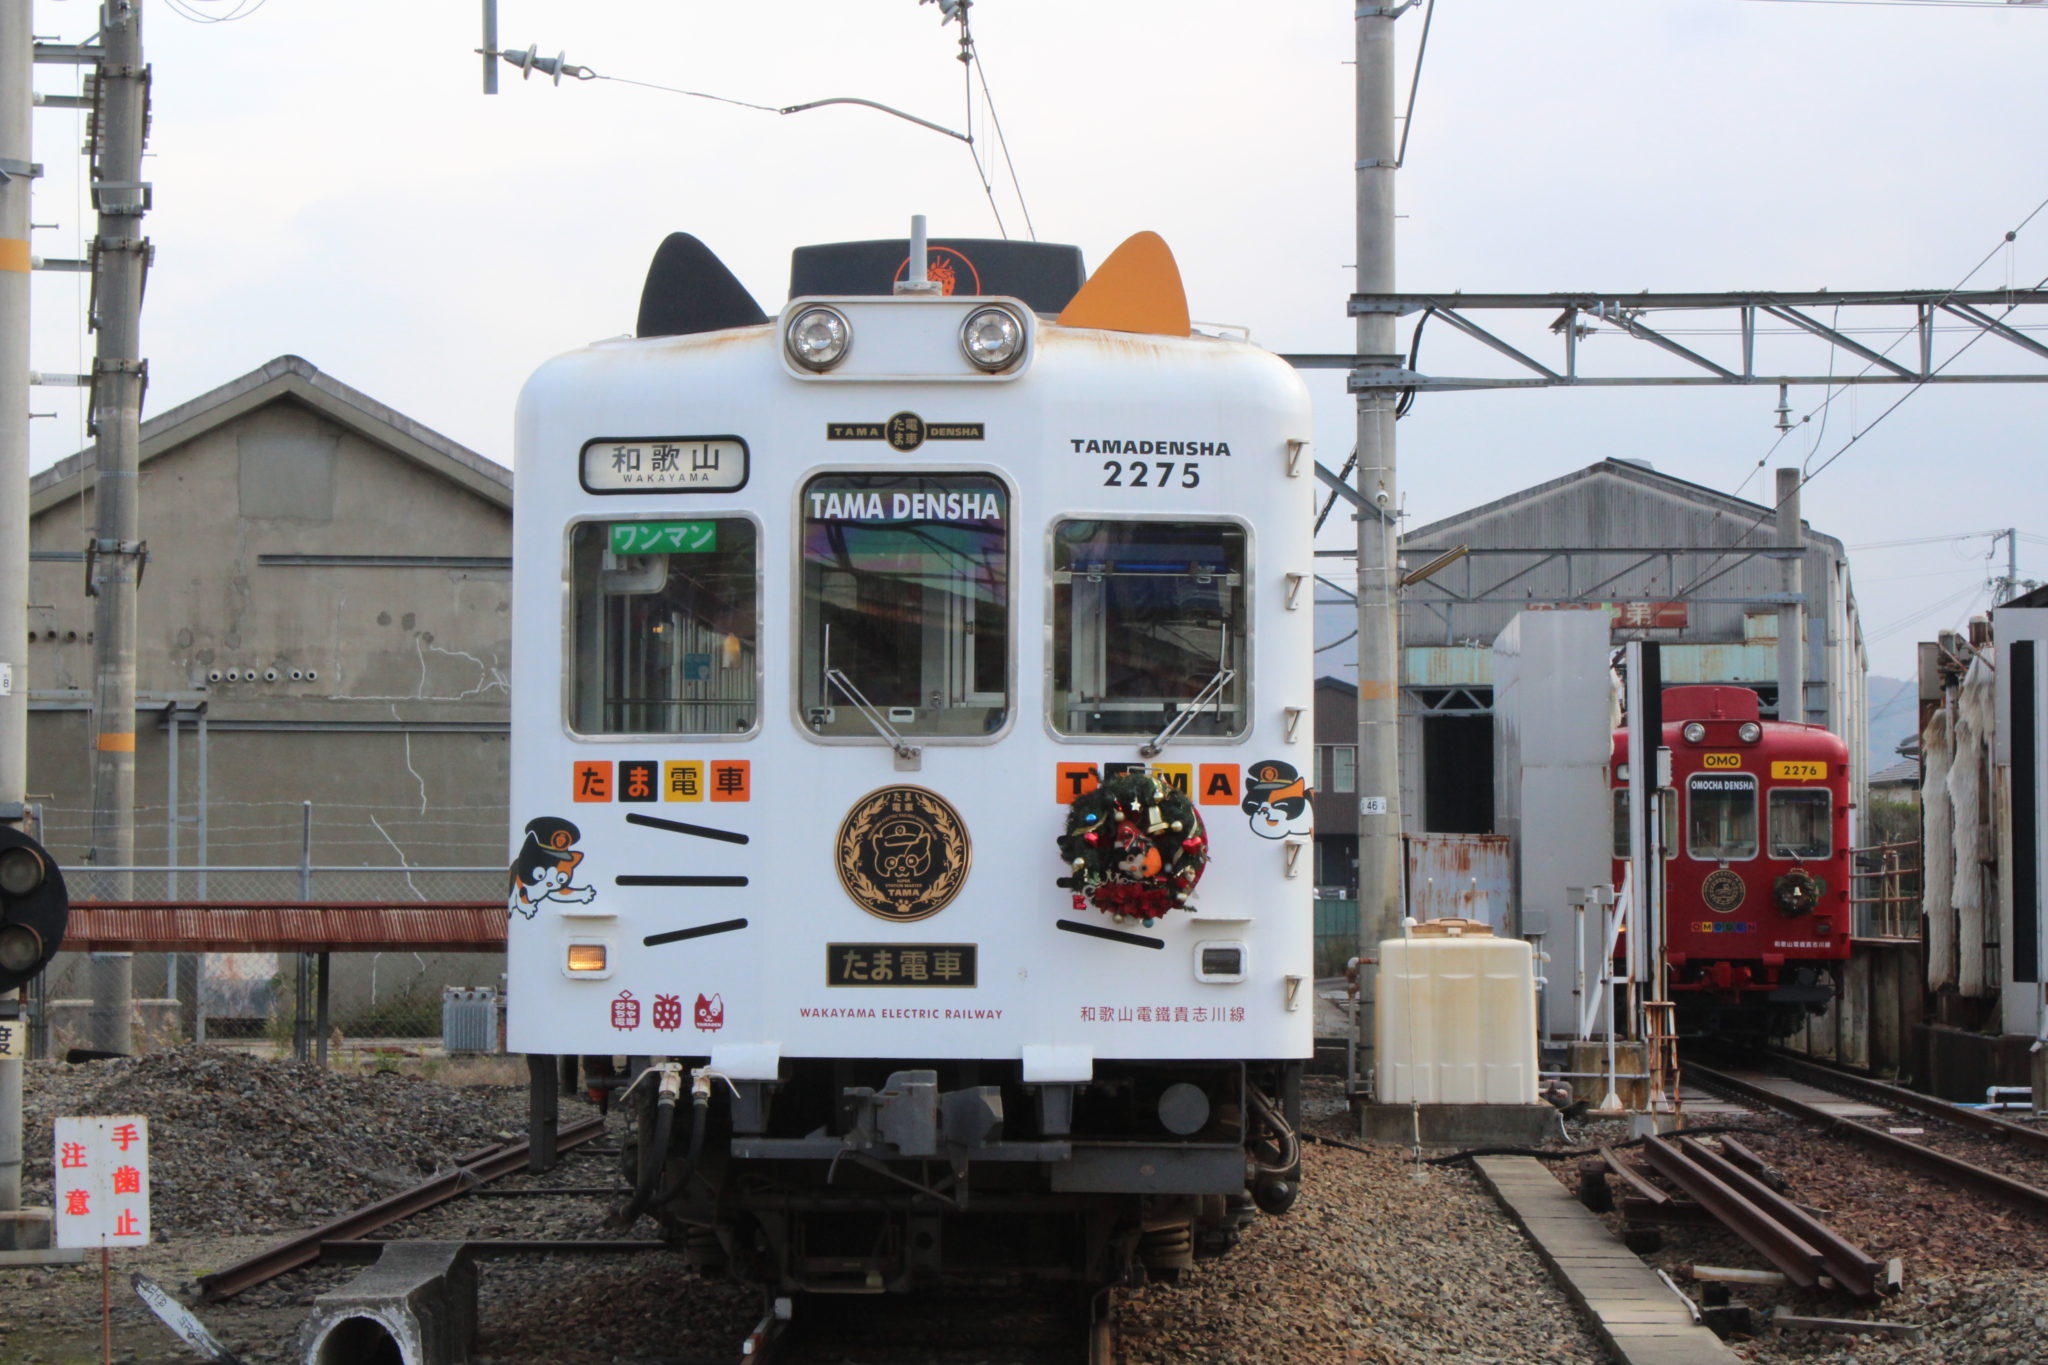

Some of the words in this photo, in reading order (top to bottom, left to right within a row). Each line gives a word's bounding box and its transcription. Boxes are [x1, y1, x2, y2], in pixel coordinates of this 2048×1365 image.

[834, 427, 879, 436] TAMA
[930, 427, 979, 436] DENSHA
[1070, 439, 1231, 457] TAMADENSHA
[611, 444, 720, 473] 和歌山
[623, 473, 709, 483] WAKAYAMA
[1103, 460, 1200, 488] 2275
[811, 492, 884, 519] TAMA
[893, 493, 1000, 520] DENSHA
[614, 525, 714, 550] ワンマン
[1705, 755, 1739, 766] OMO
[1783, 765, 1817, 776] 2276
[582, 766, 744, 797] たま電車
[1065, 772, 1233, 797] TMA
[1691, 780, 1723, 790] OMOCHA
[1724, 780, 1754, 790] DENSHA
[1366, 800, 1378, 811] 46
[887, 888, 920, 897] TAMA
[842, 949, 962, 981] たま電車
[800, 1008, 876, 1018] WAKAYAMA
[881, 1008, 940, 1019] ELECTRIC
[944, 1009, 1003, 1019] RAILWAY
[1080, 1006, 1246, 1023] 和歌山電鐵貴志川線
[61, 1142, 91, 1216] 注意
[111, 1123, 141, 1236] 手歯止
